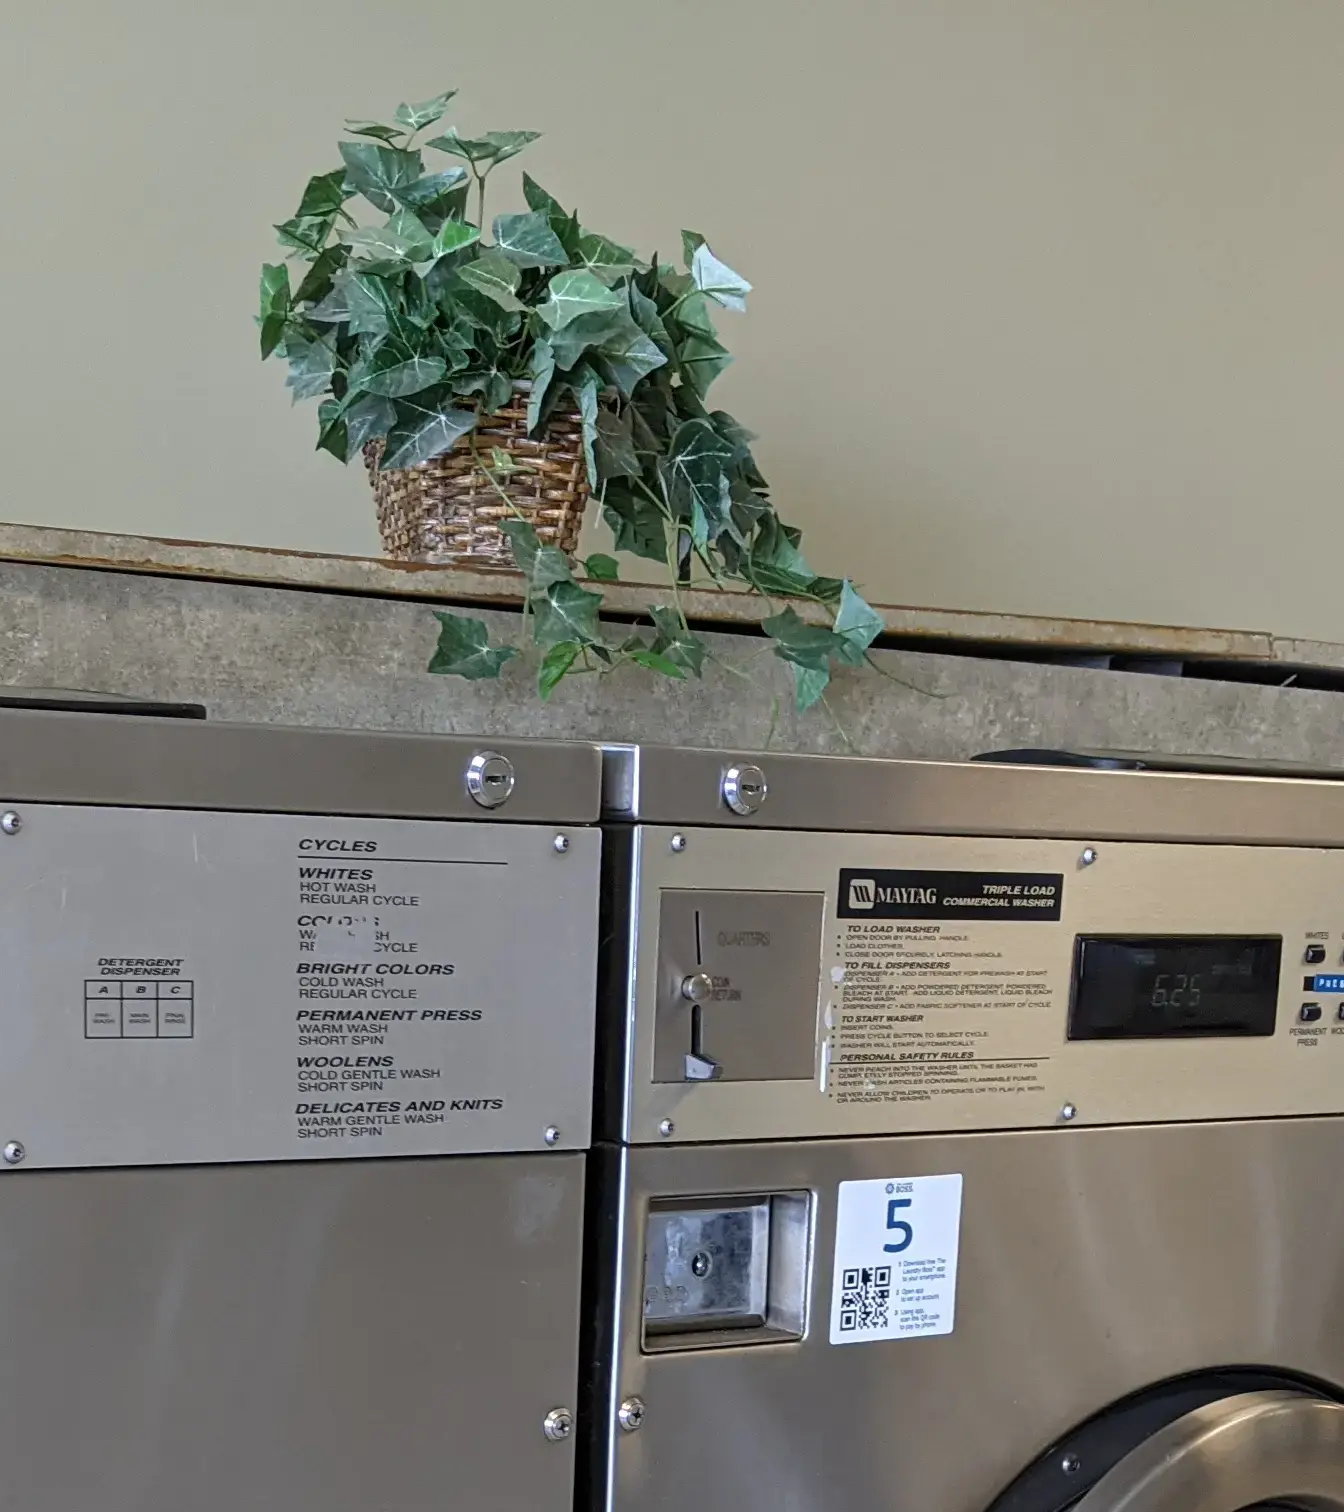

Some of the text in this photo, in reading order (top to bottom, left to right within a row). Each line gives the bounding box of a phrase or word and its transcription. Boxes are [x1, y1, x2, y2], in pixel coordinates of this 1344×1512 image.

[299, 839, 378, 852] CYCLES
[299, 867, 373, 880] WHITES
[300, 882, 376, 893] HOT WASH
[982, 885, 1055, 896] TRIPLE LOAD
[300, 894, 420, 906] REGULAR CYCLE
[877, 887, 937, 904] MAYTAG
[943, 897, 1055, 908] COMMERCIAL WASHER
[847, 925, 941, 933] TO LOAD WASHER
[97, 958, 185, 967] DETERGENT
[100, 967, 181, 976] DISPENSER
[296, 962, 455, 975] BRIGHT COLORS
[299, 977, 384, 988] COLD WASH
[98, 986, 109, 994] A
[136, 985, 147, 994] B
[170, 986, 181, 994] C
[299, 989, 417, 999] REGULAR CYCLE
[295, 1010, 482, 1021] PERMANENT PRESS
[842, 1015, 854, 1023] TO
[886, 1014, 924, 1022] WASHER
[298, 1024, 388, 1034] WARM WASH
[298, 1036, 384, 1046] SHORT SPIN
[840, 1051, 974, 1061] PERSONAL SAFETY RULES
[296, 1056, 394, 1068] WOOLENS
[298, 1069, 440, 1080] COLD GENTLE WASH
[297, 1081, 383, 1092] SHORT SPIN
[295, 1099, 504, 1114] DELICATES AND KNITS
[297, 1114, 444, 1127] WARM GENTLE WASH
[297, 1127, 382, 1139] SHORT SPIN
[883, 1198, 913, 1253] 5
